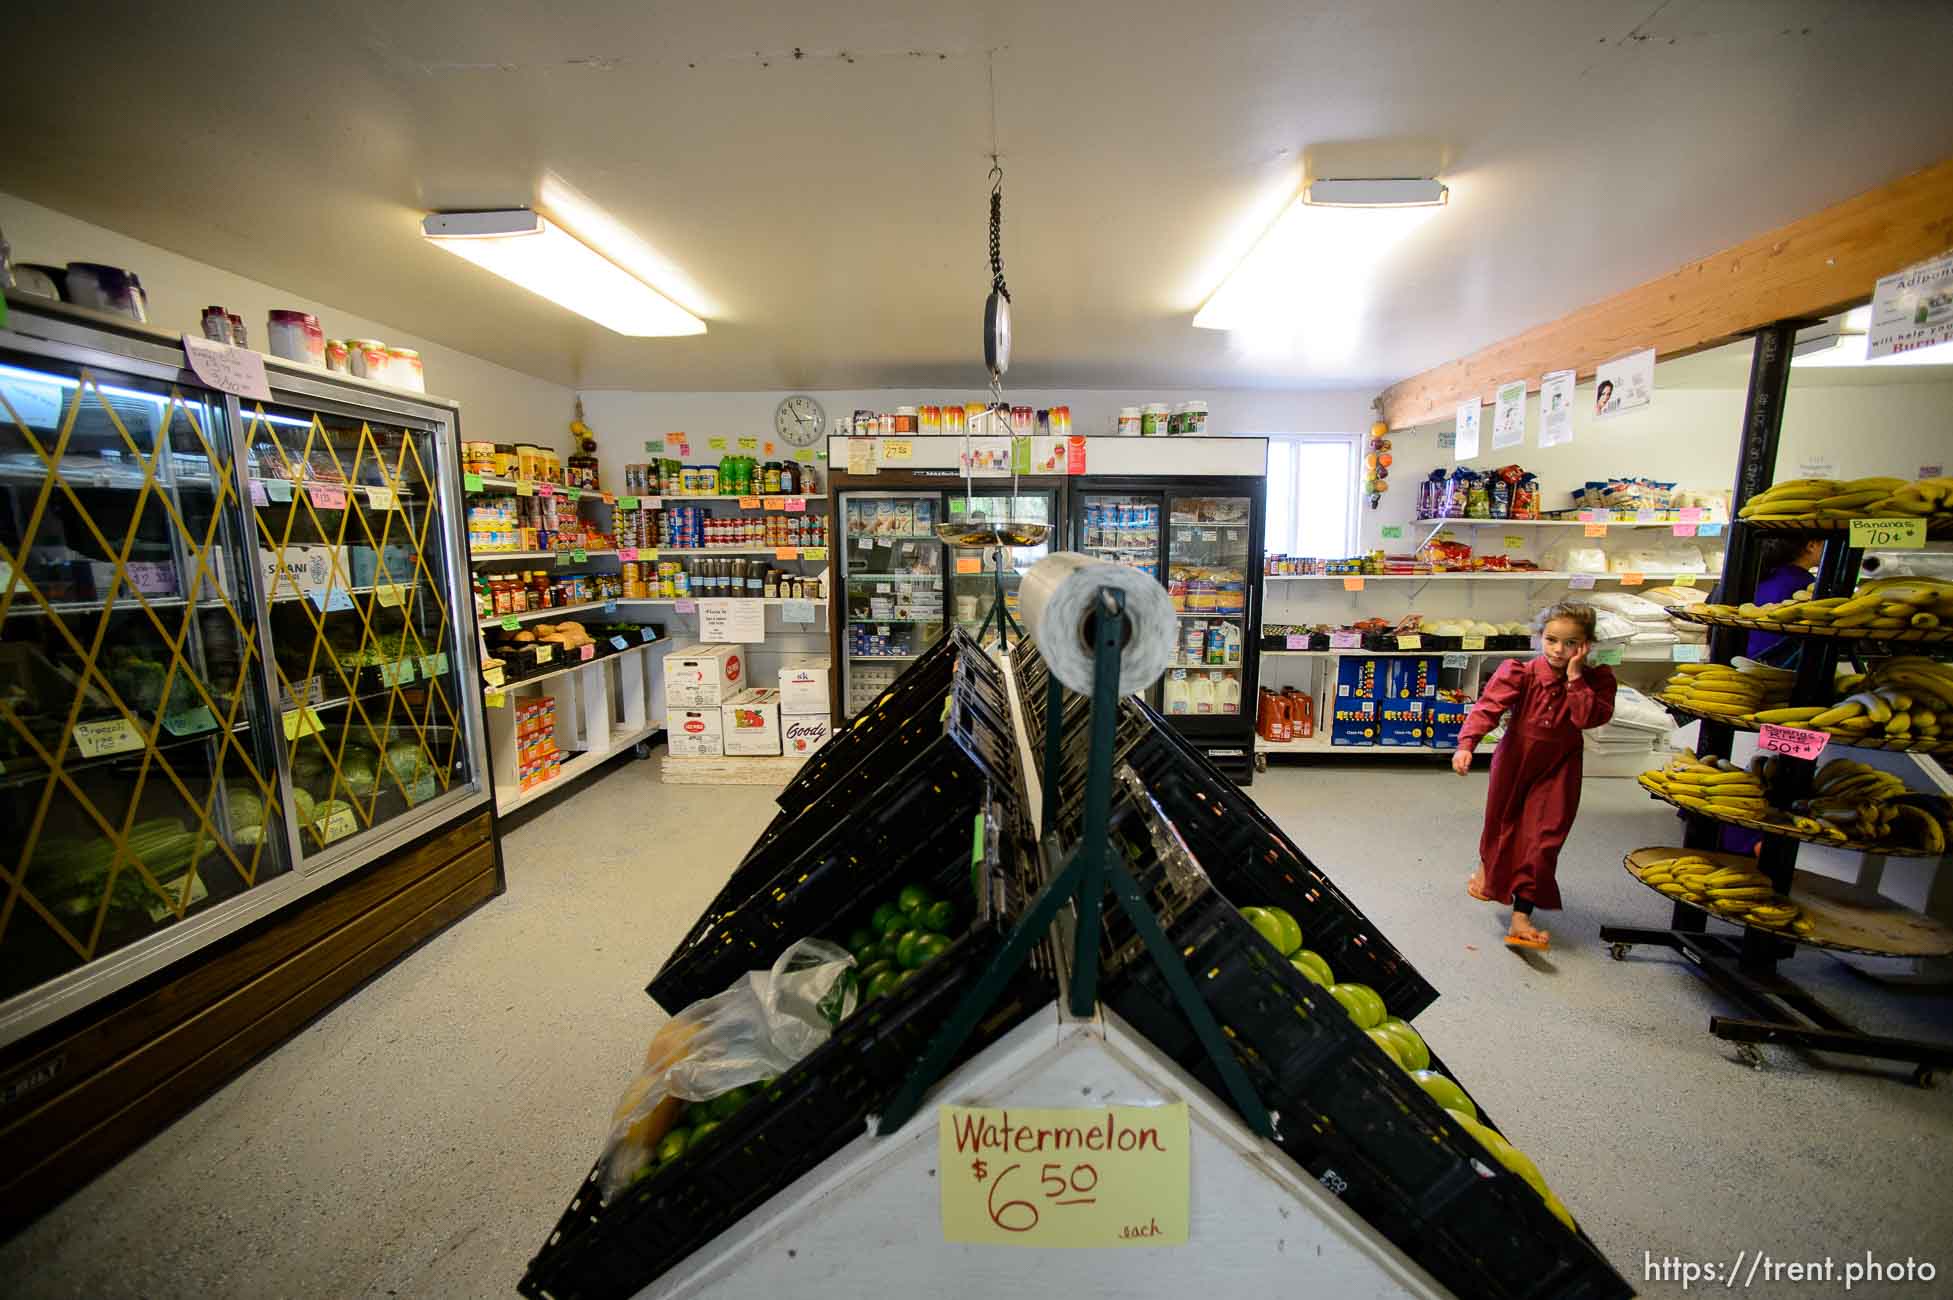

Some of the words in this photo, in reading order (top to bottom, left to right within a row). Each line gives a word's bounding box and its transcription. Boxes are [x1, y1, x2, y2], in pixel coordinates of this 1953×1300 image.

[1872, 336, 1893, 348] will
[1898, 328, 1925, 341] help
[1892, 338, 1936, 354] Burn
[1853, 519, 1916, 530] Bananas
[786, 722, 828, 744] Goody
[953, 1111, 1167, 1154] Watermelon
[1118, 1218, 1163, 1240] each
